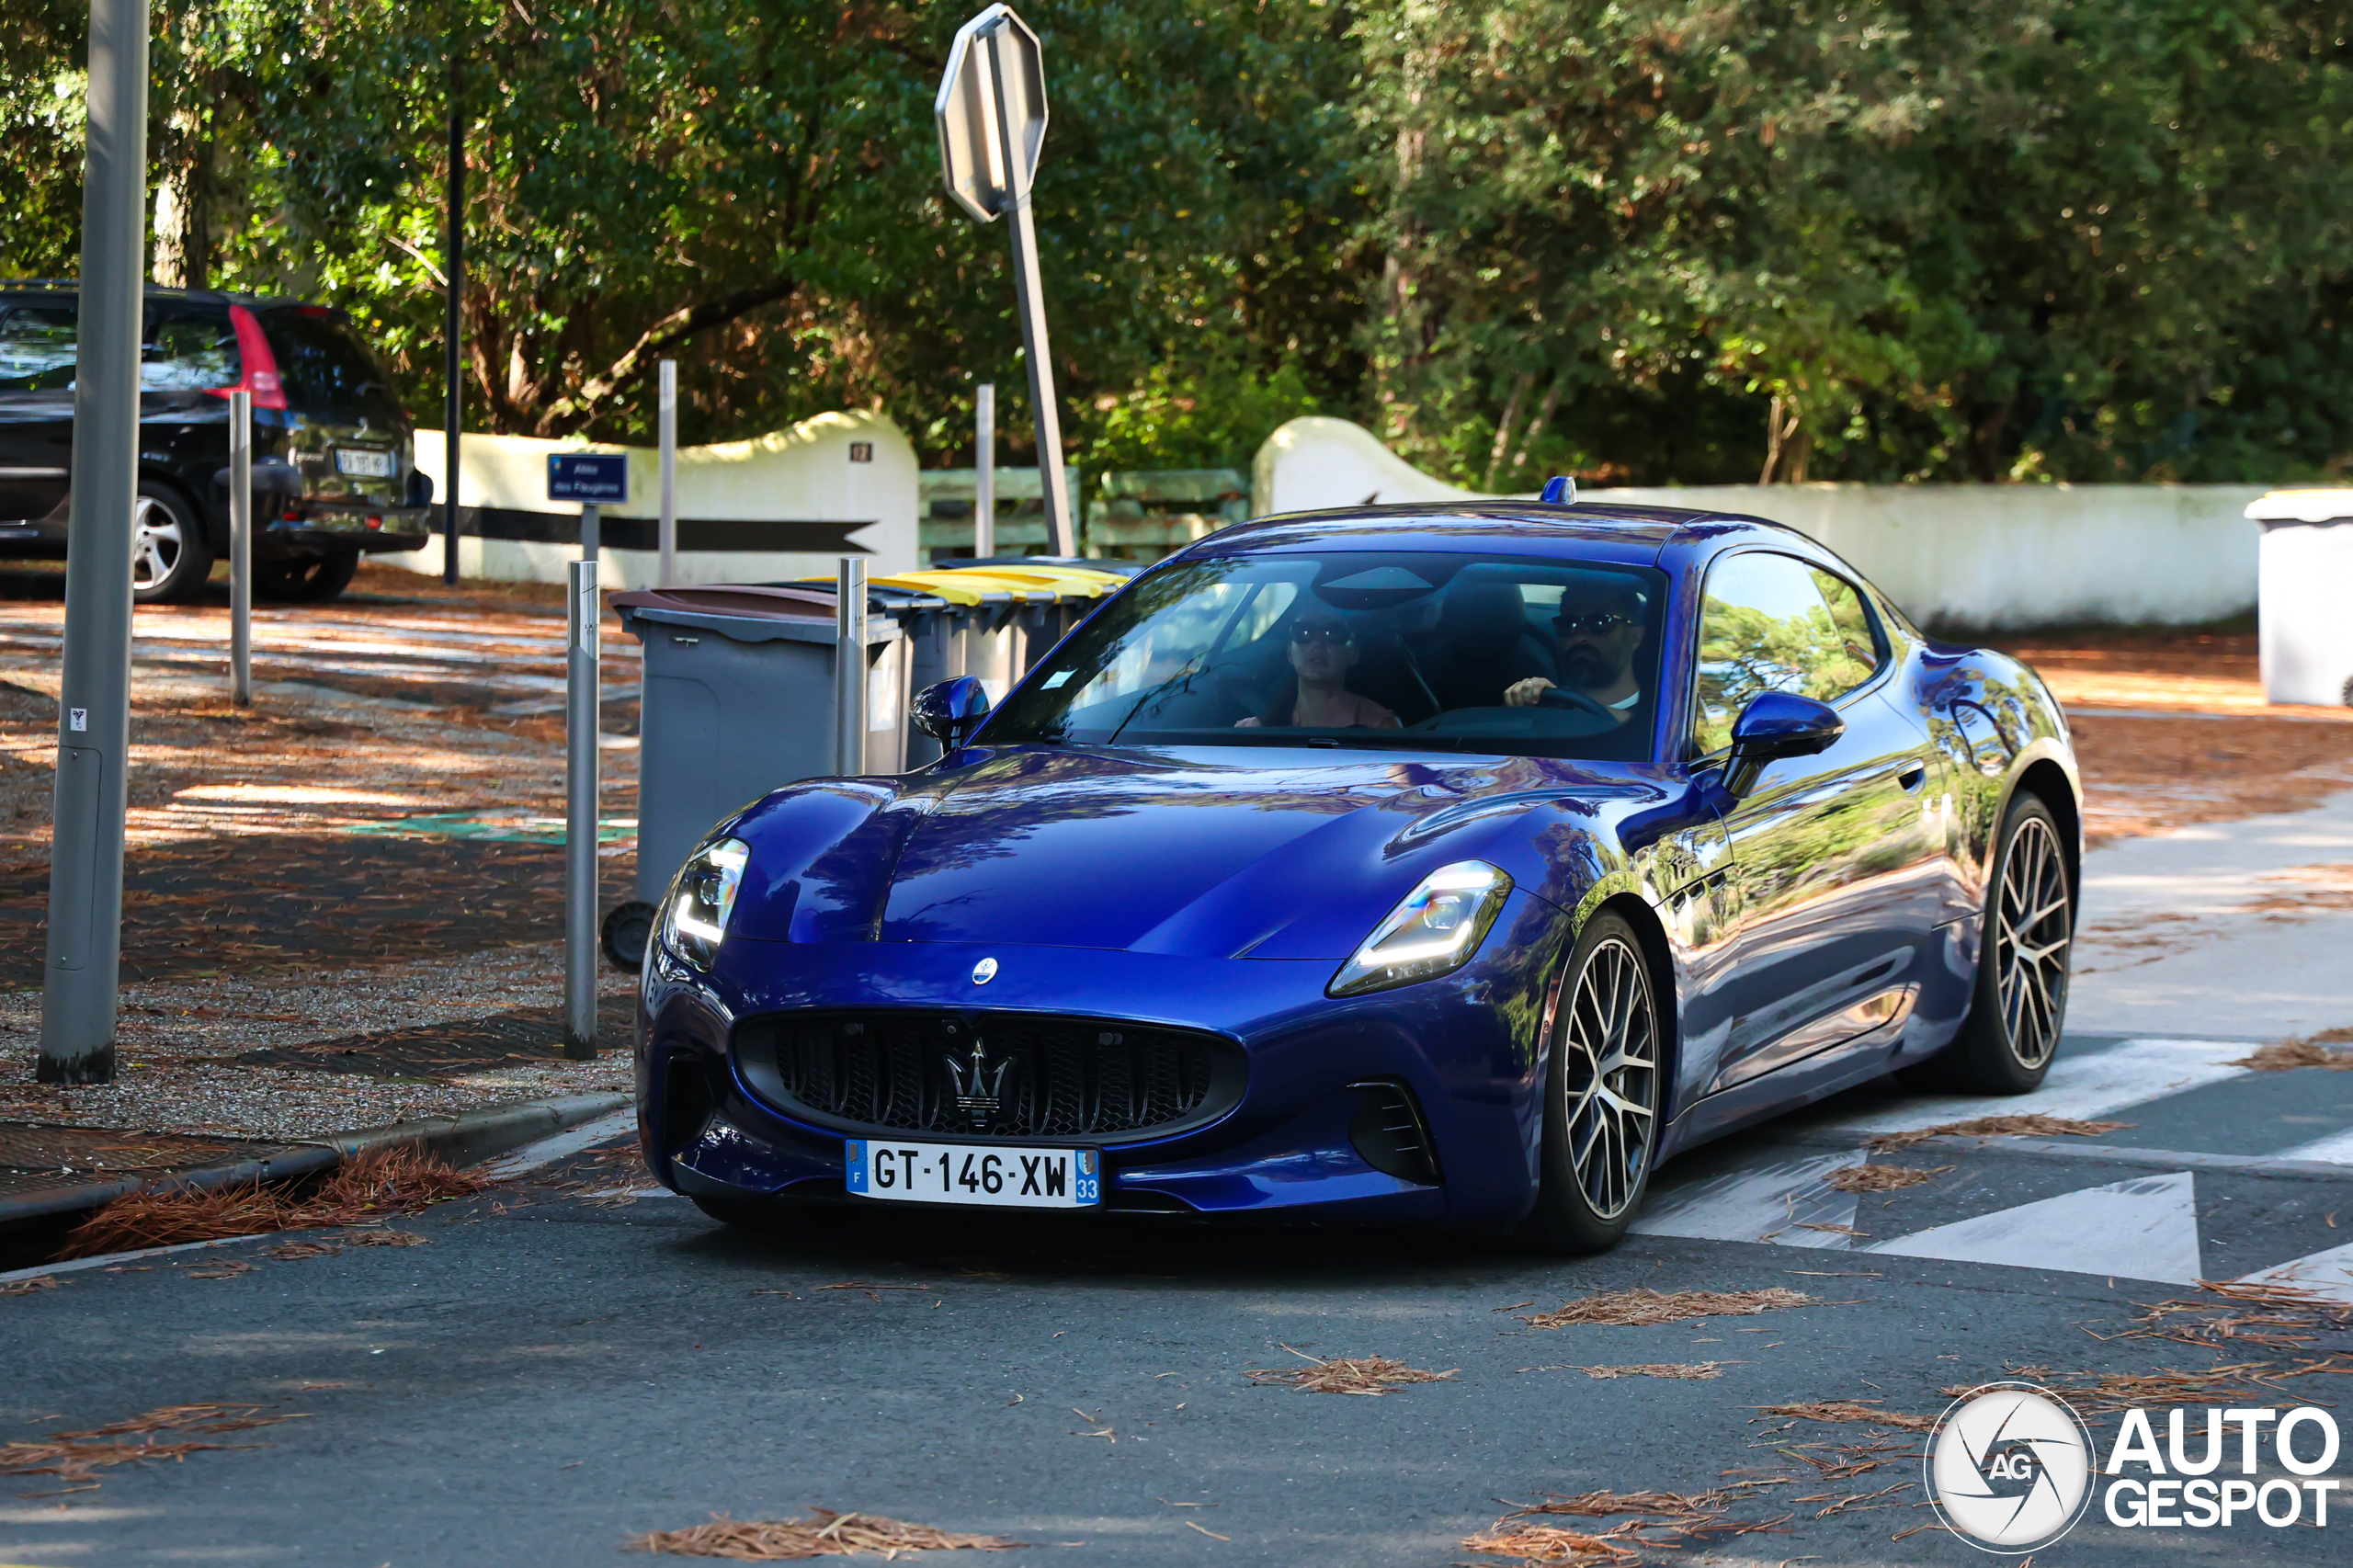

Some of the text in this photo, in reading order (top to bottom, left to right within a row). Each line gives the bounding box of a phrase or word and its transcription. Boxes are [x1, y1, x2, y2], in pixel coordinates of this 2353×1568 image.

[854, 1172, 861, 1184] F
[875, 1149, 1066, 1197] GT-146-XW
[1077, 1179, 1097, 1199] 33
